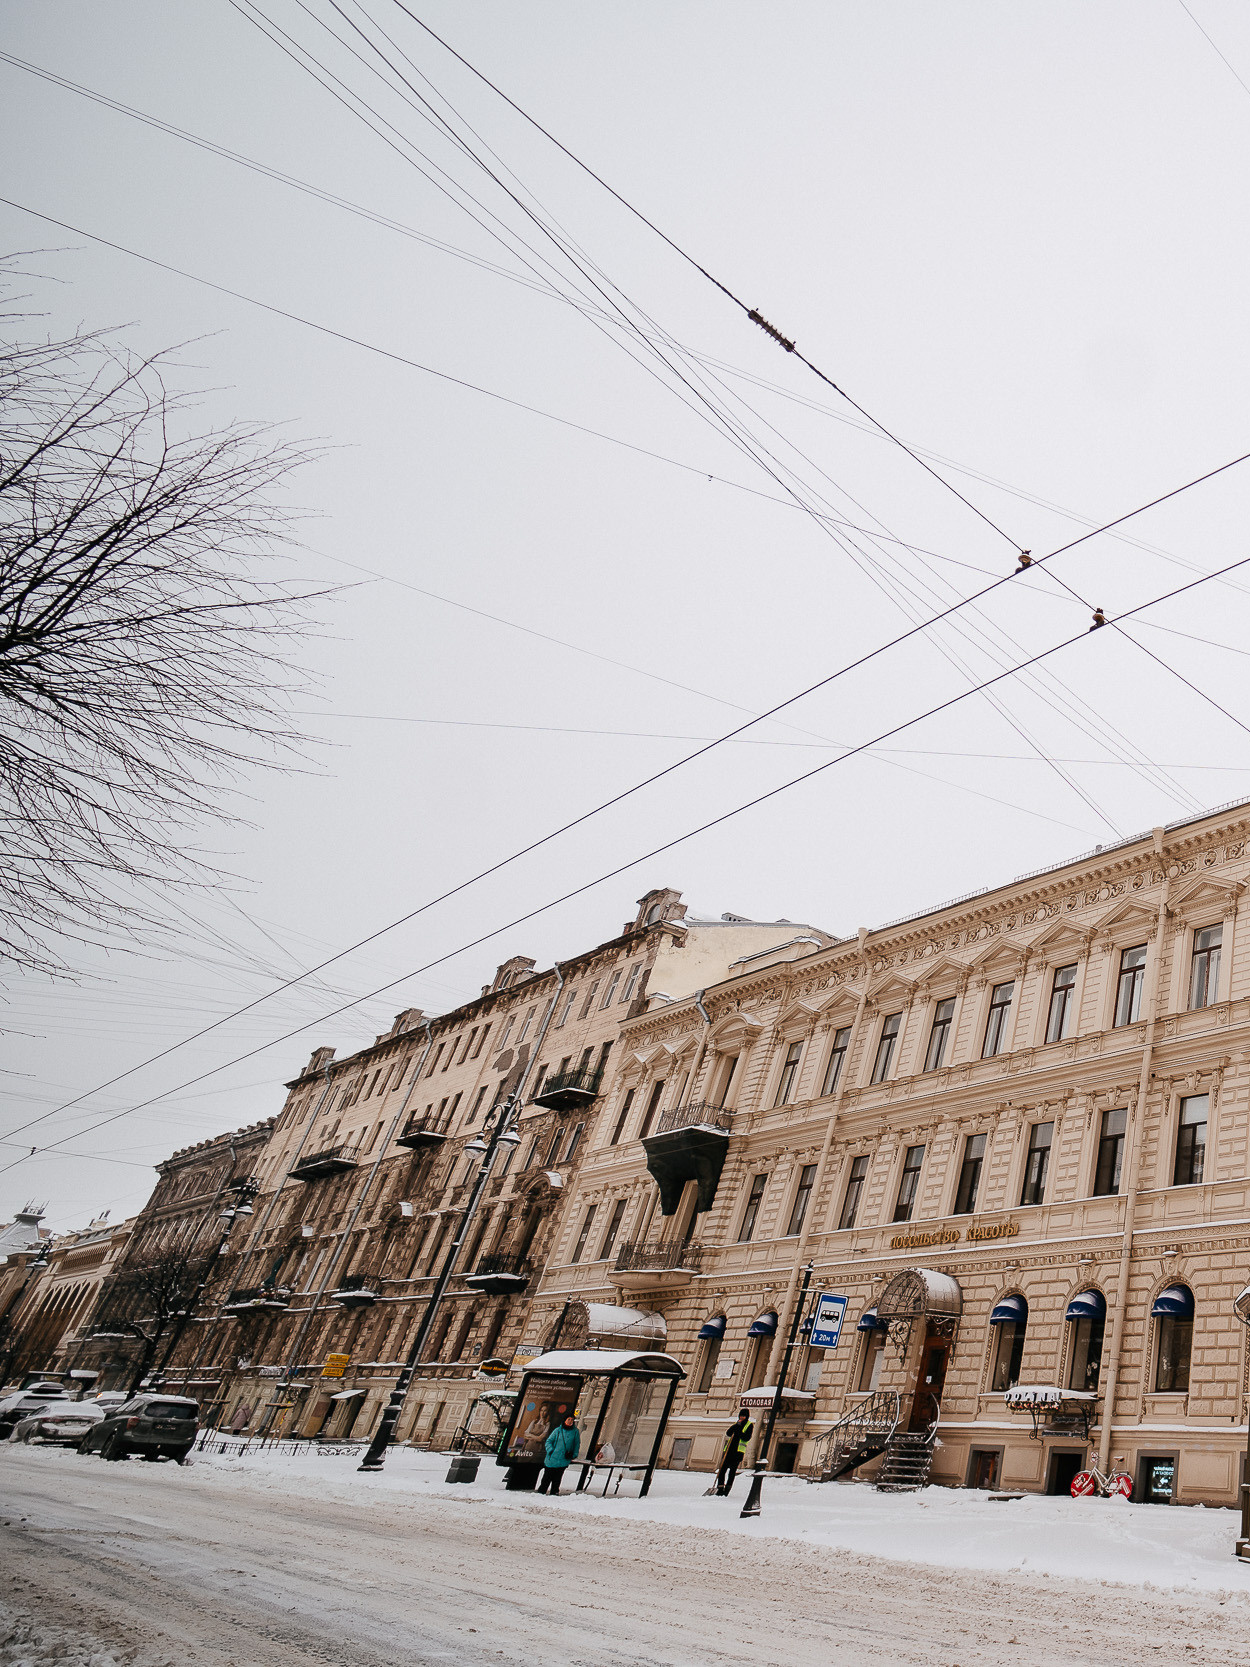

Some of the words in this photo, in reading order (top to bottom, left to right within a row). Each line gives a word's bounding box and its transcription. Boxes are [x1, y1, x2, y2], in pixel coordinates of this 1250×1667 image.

[890, 1229, 961, 1249] ПОСОЛЬСТВО
[966, 1222, 1020, 1241] КРАСОТЫ
[741, 1398, 772, 1406] СТОЛОВАЯ
